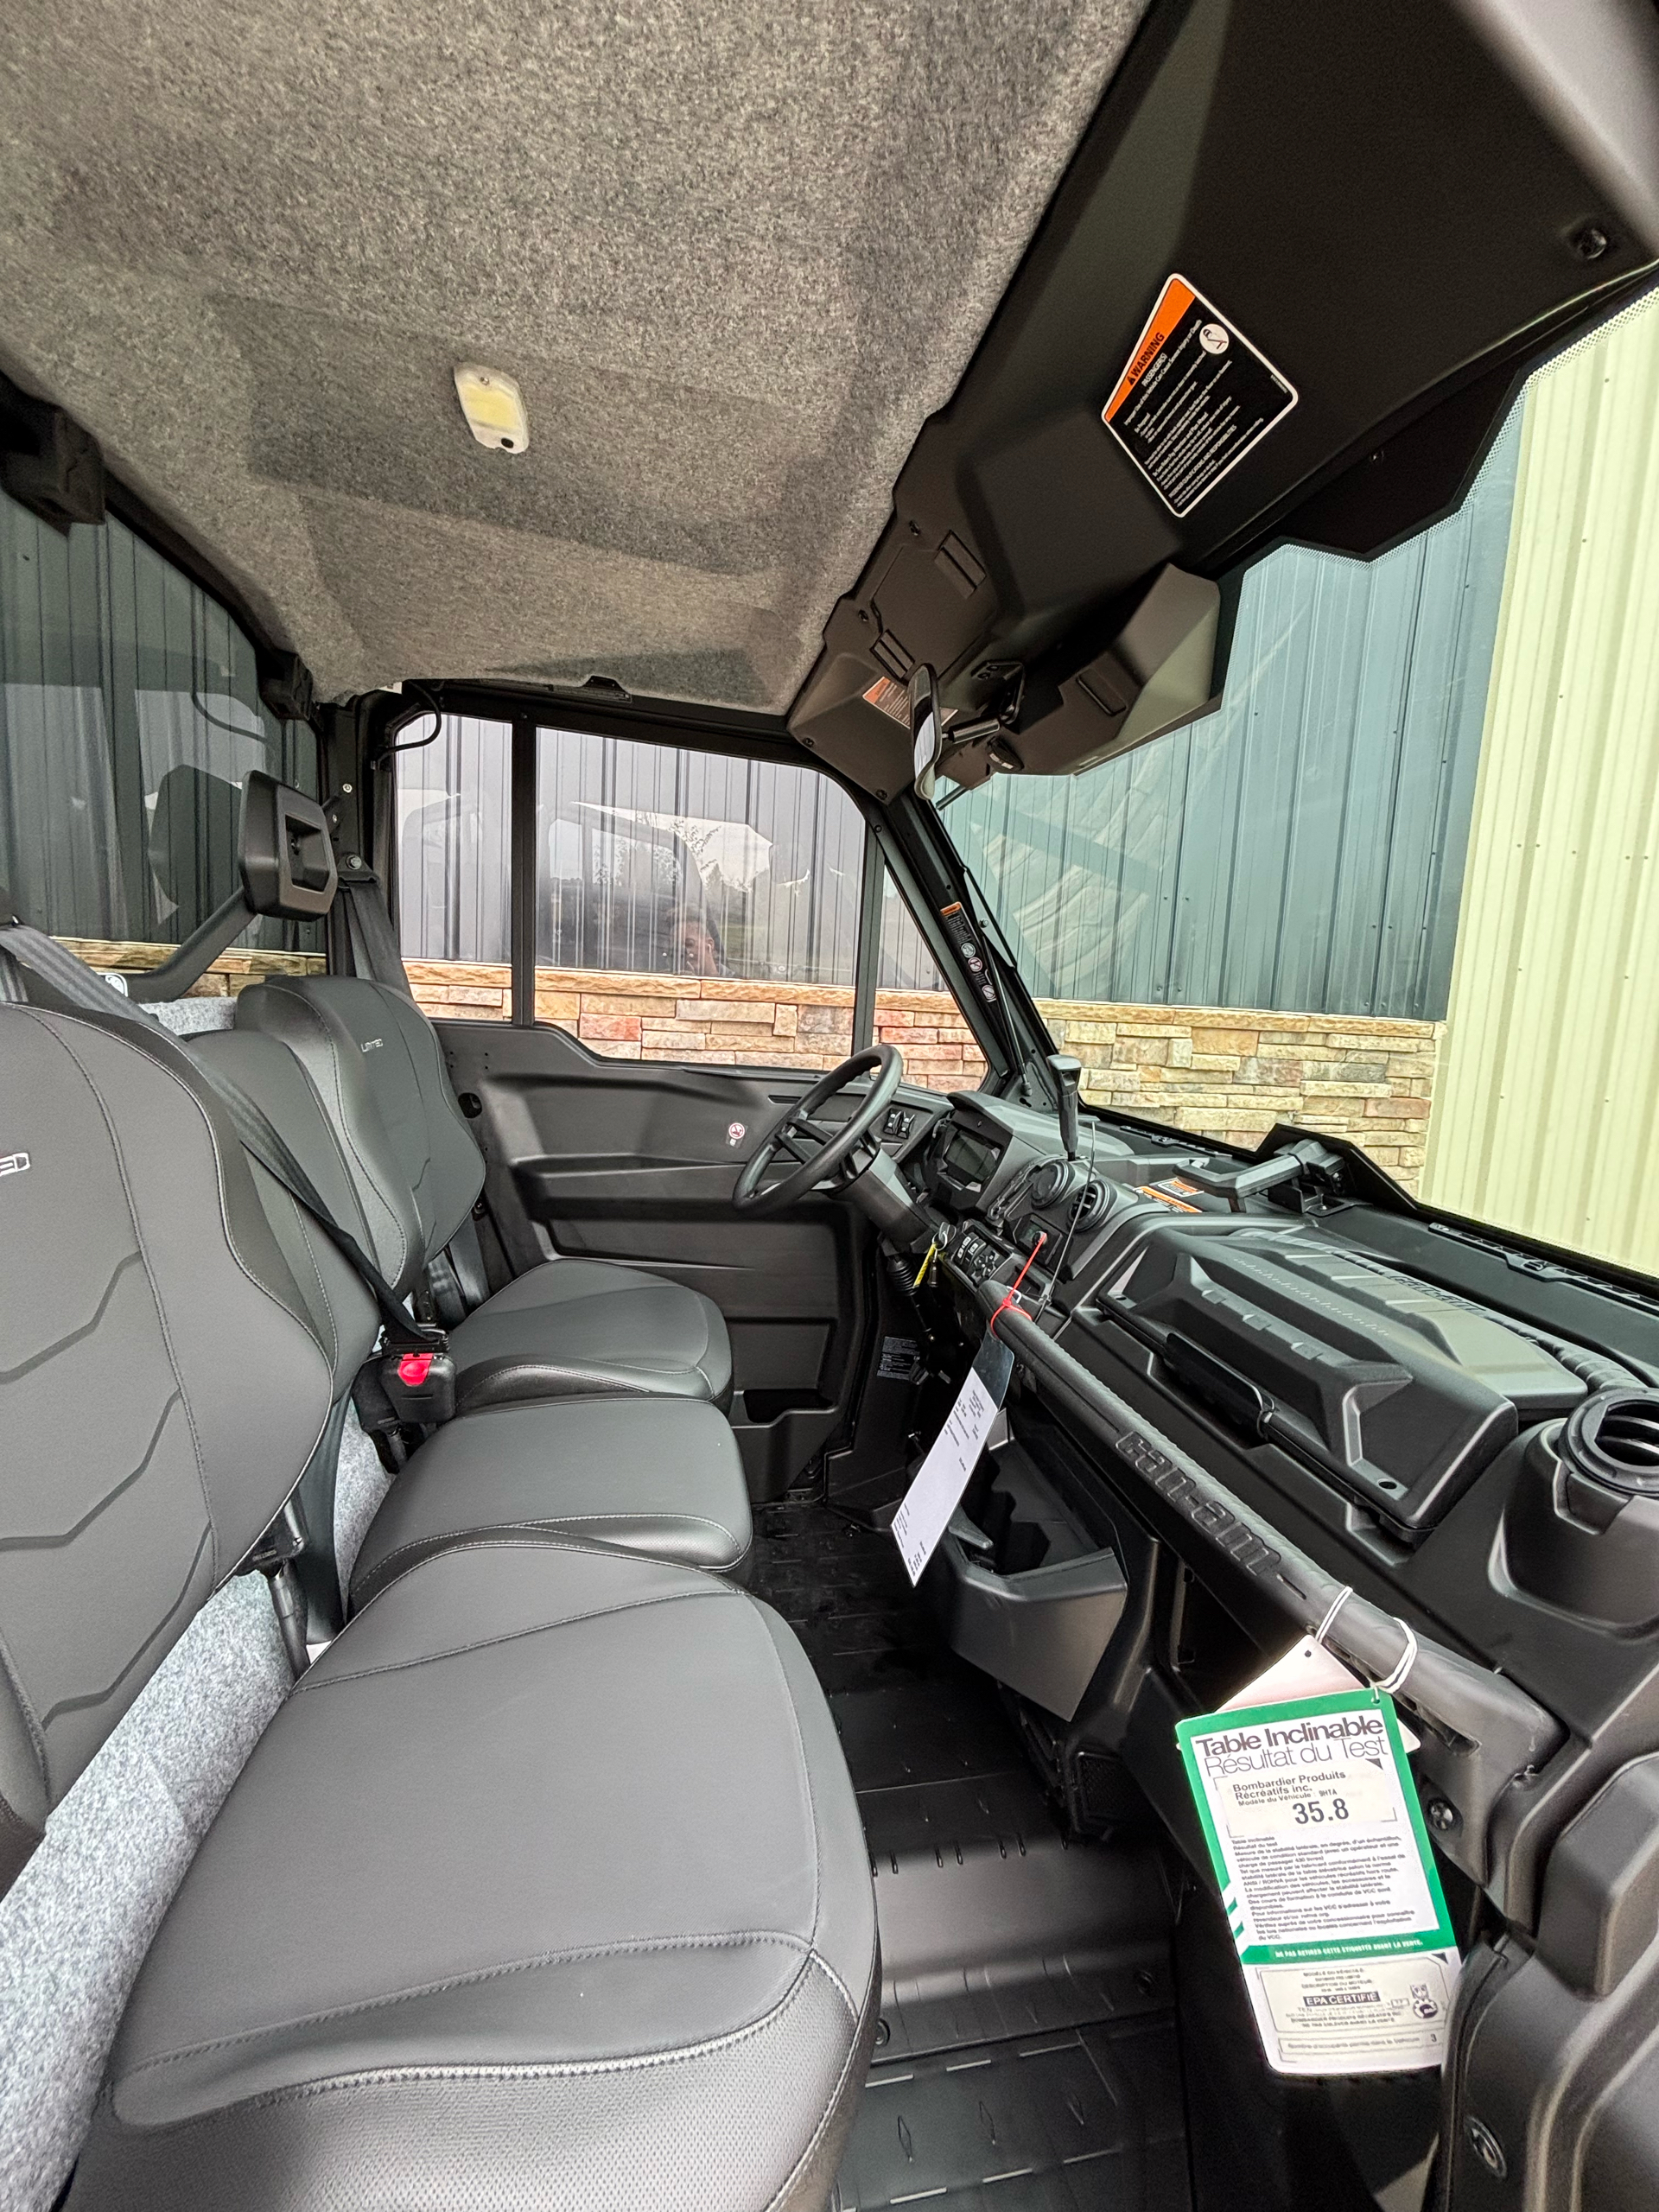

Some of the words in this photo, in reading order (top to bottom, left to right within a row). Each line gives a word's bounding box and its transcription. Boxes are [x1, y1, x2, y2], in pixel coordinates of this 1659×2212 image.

[1130, 332, 1165, 377] WARNING
[1194, 1732, 1262, 1757] Table
[1263, 1714, 1383, 1747] Inclinable
[1204, 1745, 1297, 1777] Résultat
[1300, 1742, 1332, 1764] du
[1333, 1735, 1389, 1758] Test
[1232, 1777, 1295, 1792] Bombardier
[1298, 1770, 1346, 1783] Produits
[1234, 1786, 1289, 1800] Récréatifs
[1291, 1784, 1313, 1793] inc.
[1277, 1792, 1311, 1801] Véhicule
[1292, 1797, 1349, 1824] 35.8
[1306, 1995, 1328, 2005] EPA
